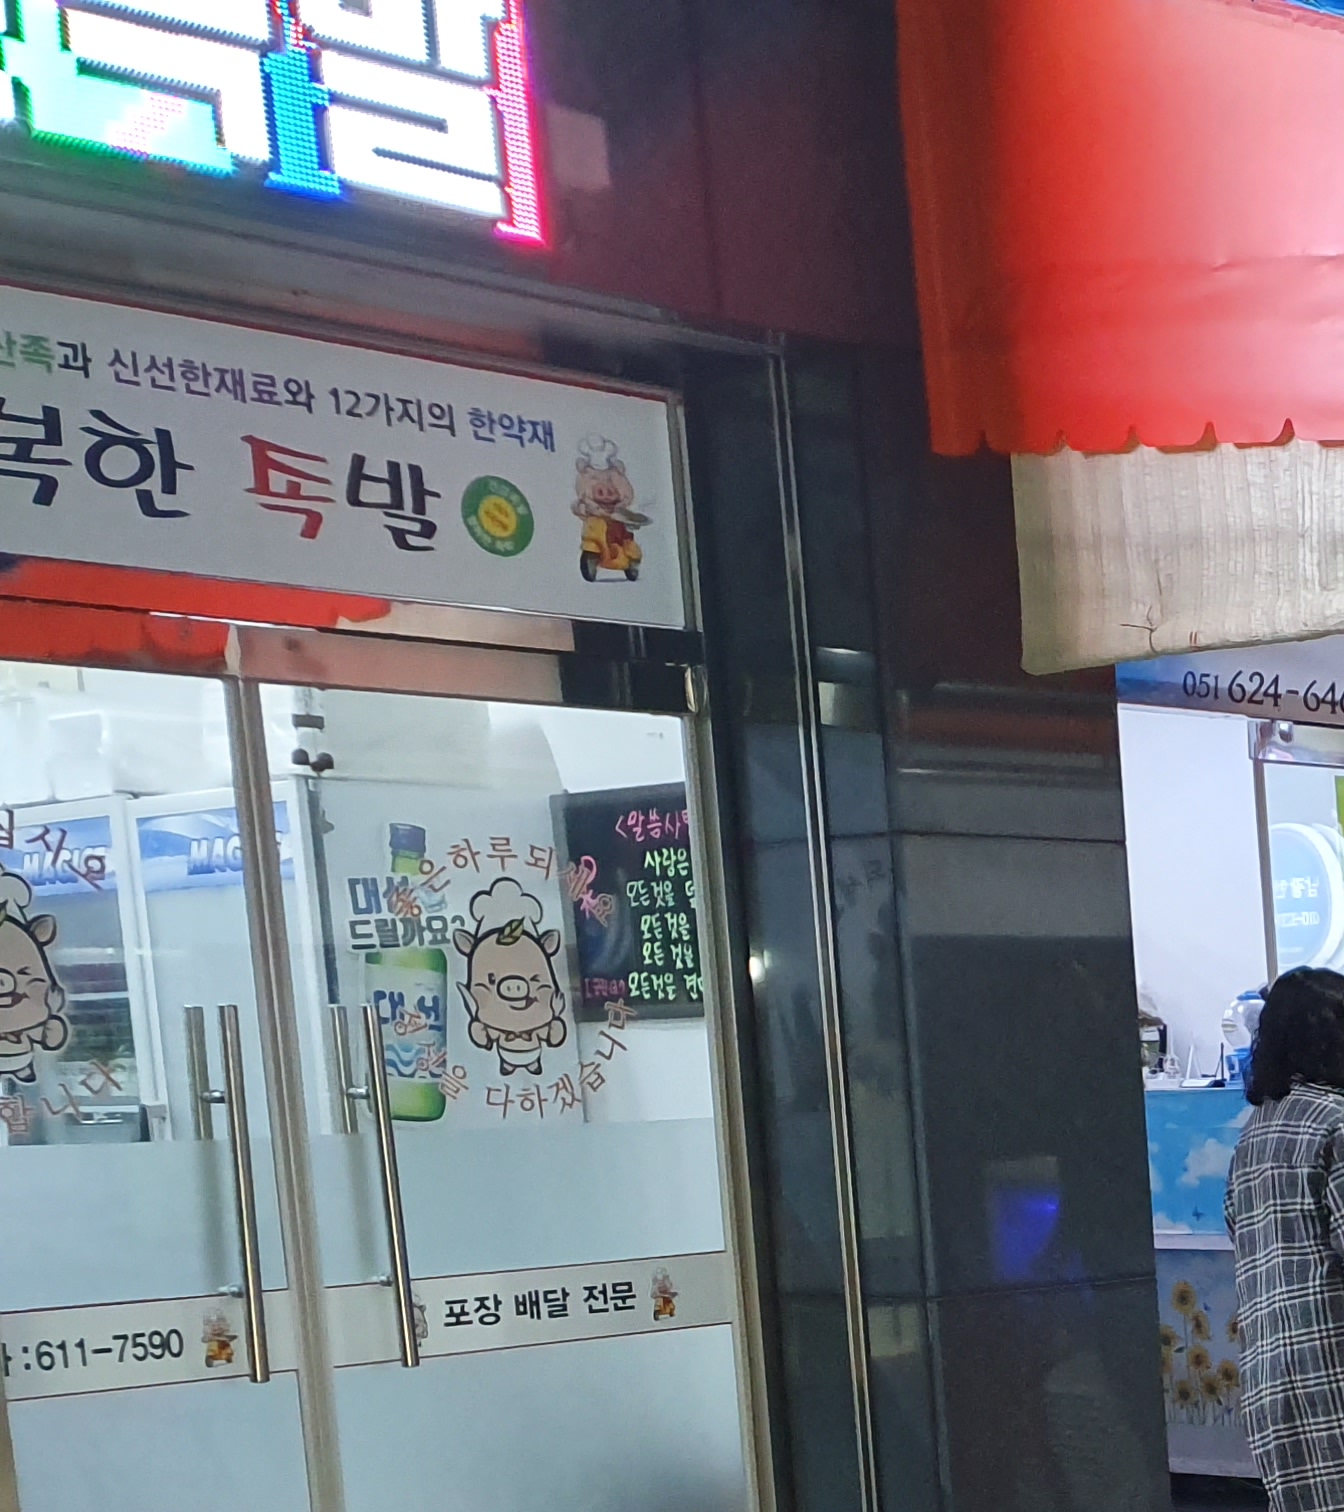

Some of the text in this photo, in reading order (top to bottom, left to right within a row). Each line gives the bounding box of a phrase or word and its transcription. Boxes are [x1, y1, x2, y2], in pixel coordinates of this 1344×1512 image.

[328, 386, 457, 438] 12가지의
[467, 407, 556, 452] 한약재
[1183, 670, 1220, 700] 051
[349, 915, 465, 950] 드릴까요?
[443, 1280, 638, 1328] 포장 배달 전문
